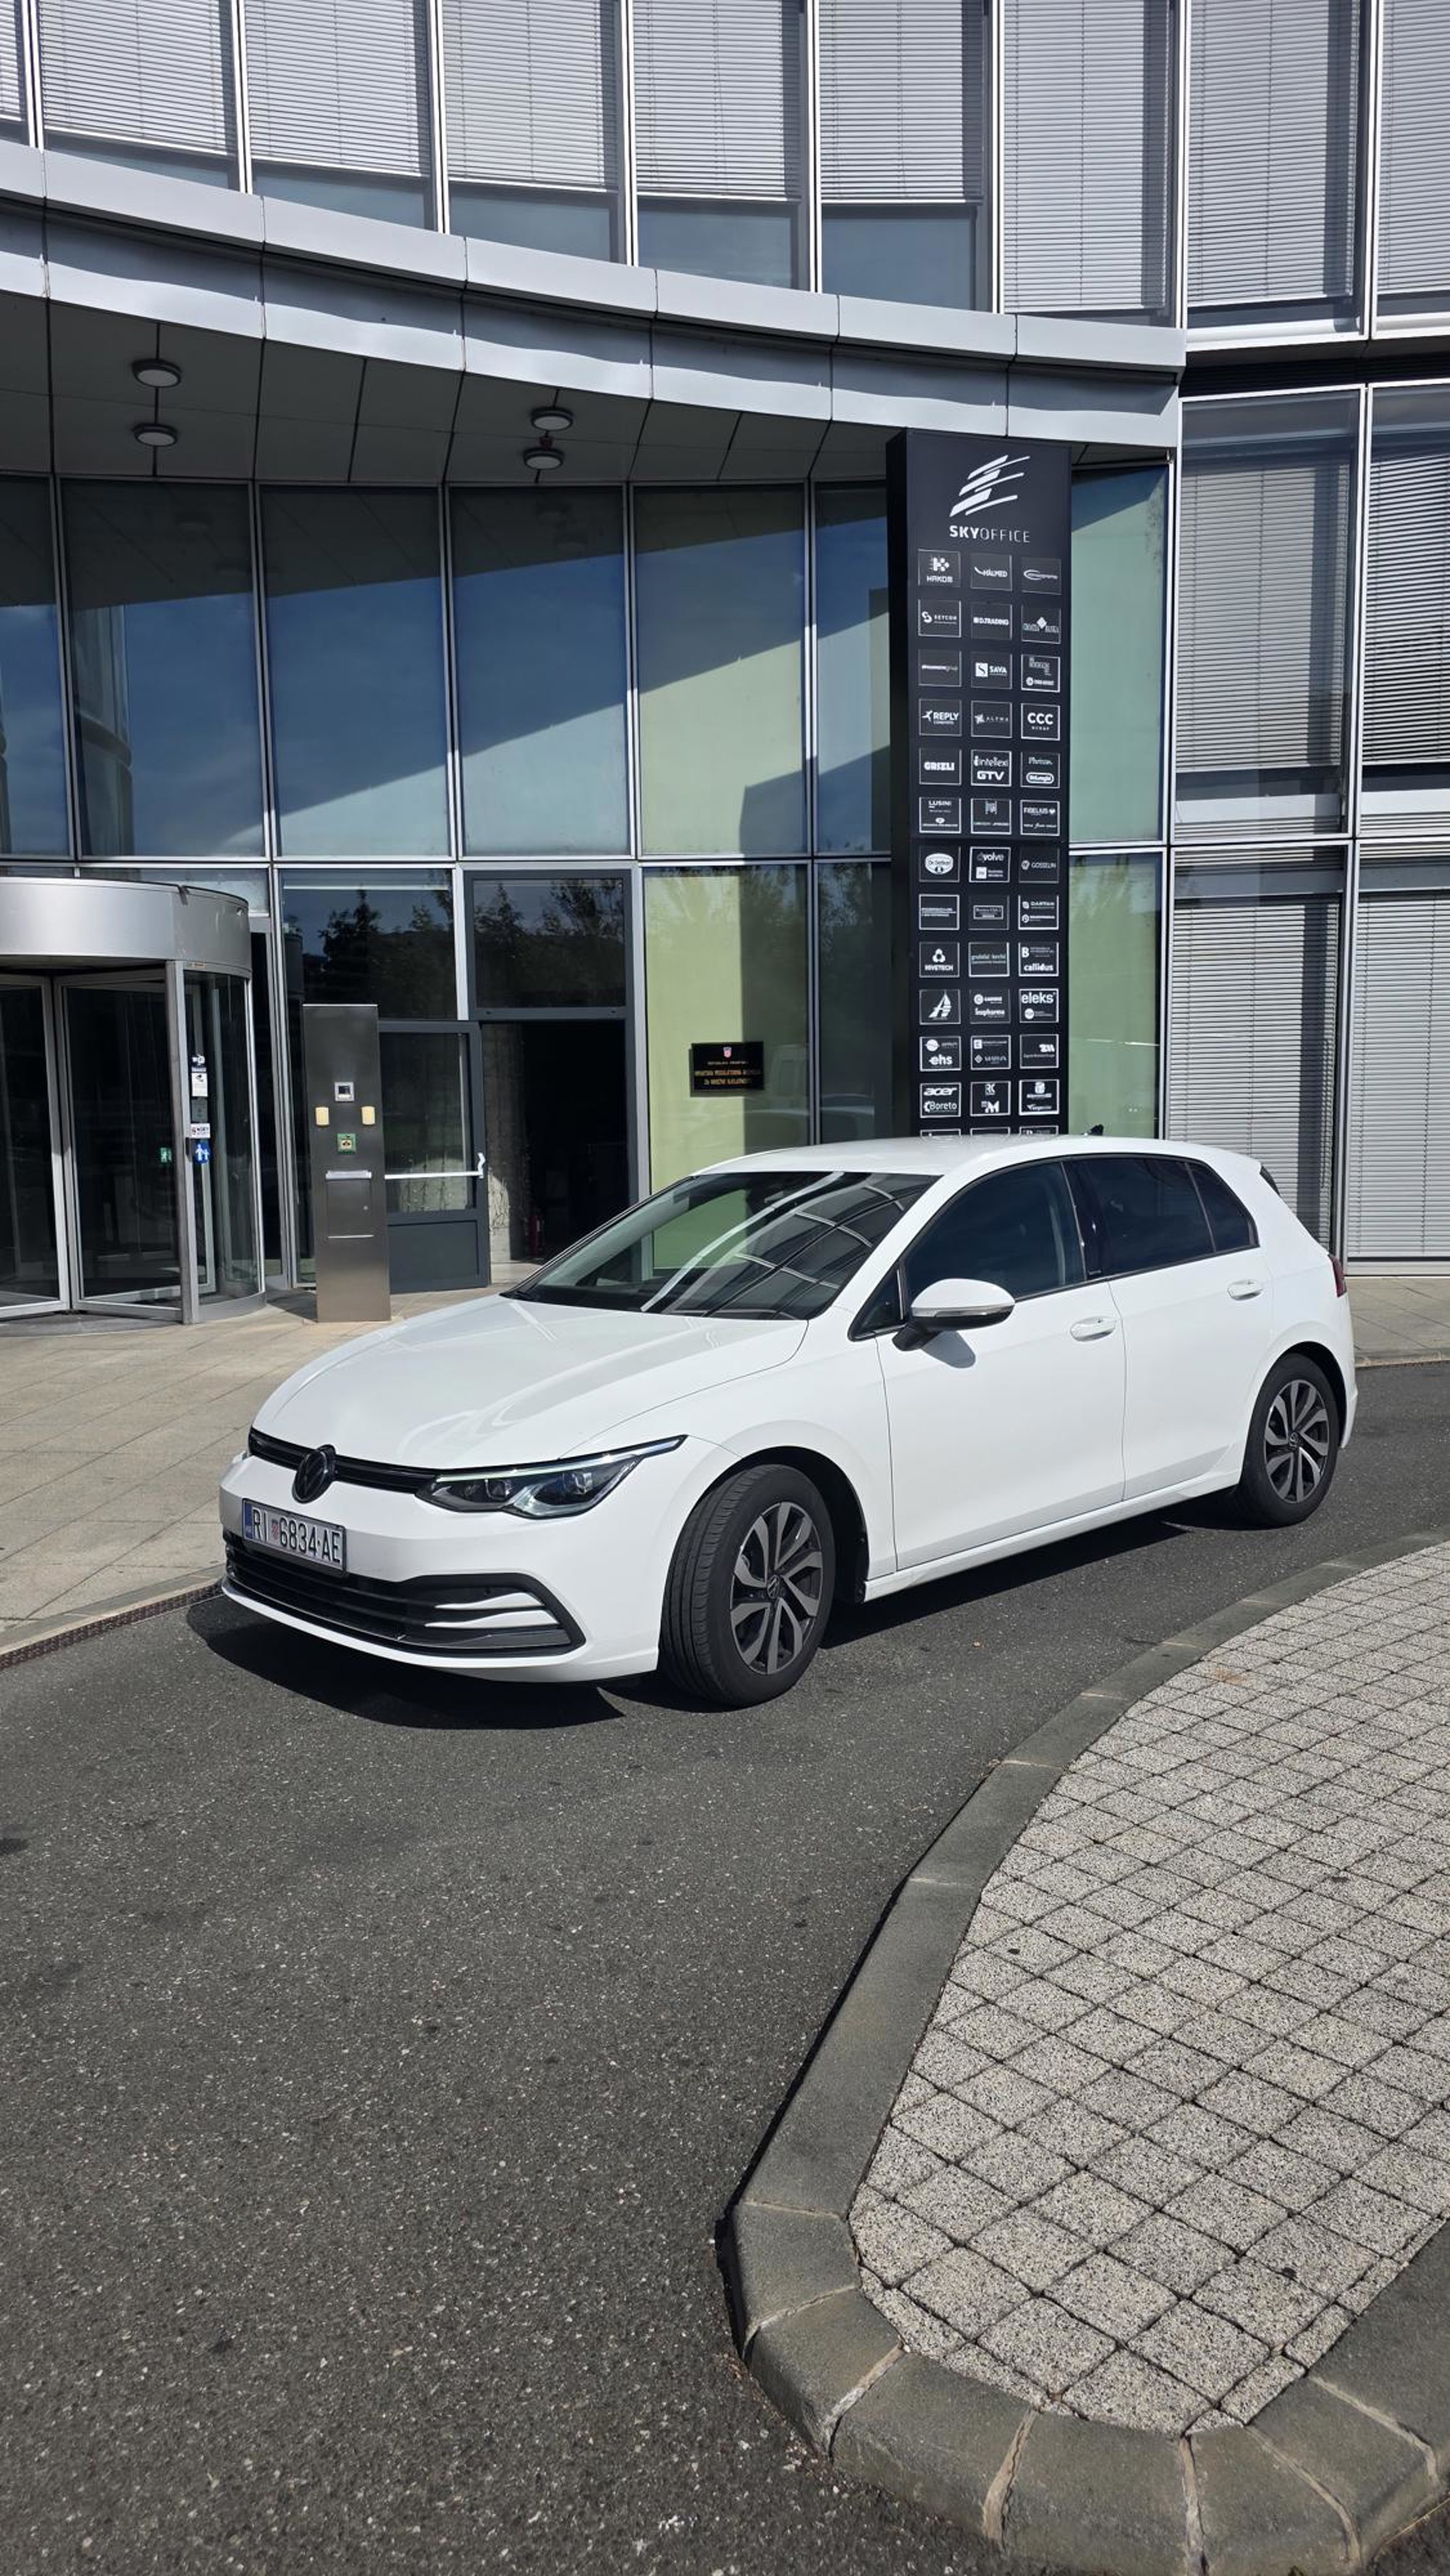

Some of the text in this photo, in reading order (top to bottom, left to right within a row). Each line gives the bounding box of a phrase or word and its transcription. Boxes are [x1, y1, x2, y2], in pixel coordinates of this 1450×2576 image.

[949, 525, 1030, 542] SKYOFFICE
[933, 711, 959, 721] REPLY
[1027, 713, 1054, 725] CCC
[977, 770, 1005, 780] GTV
[1021, 991, 1054, 1004] eleks
[930, 1054, 953, 1065] ehs
[923, 1087, 958, 1097] acer
[252, 1509, 268, 1541] RI
